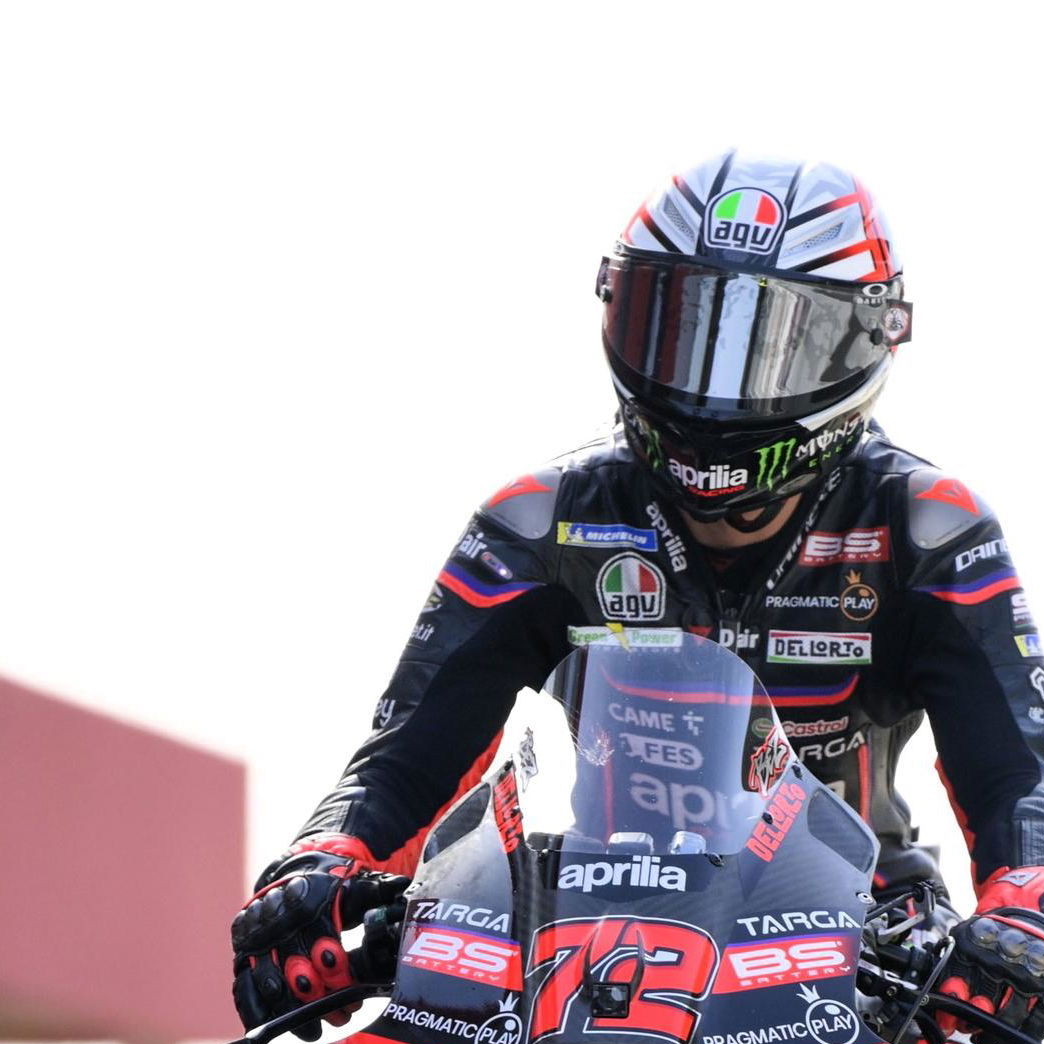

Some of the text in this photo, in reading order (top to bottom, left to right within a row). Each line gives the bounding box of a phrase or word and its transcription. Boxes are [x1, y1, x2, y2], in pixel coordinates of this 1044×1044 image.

[713, 219, 772, 249] agv
[667, 458, 748, 491] aprilia
[585, 531, 648, 545] MICHELIN
[646, 501, 688, 573] aprilia
[804, 530, 881, 557] BS
[609, 594, 656, 618] agv
[766, 595, 875, 609] PRAGMATIC PLAY
[608, 702, 675, 732] CAME
[783, 716, 849, 737] Castrol
[557, 855, 687, 892] aprilia
[412, 901, 510, 933] TARGA
[736, 910, 861, 937] TARGA
[407, 931, 514, 973] BS
[728, 941, 846, 979] BS
[383, 1003, 479, 1039] PRAGMATIC
[811, 1013, 852, 1035] PLAY
